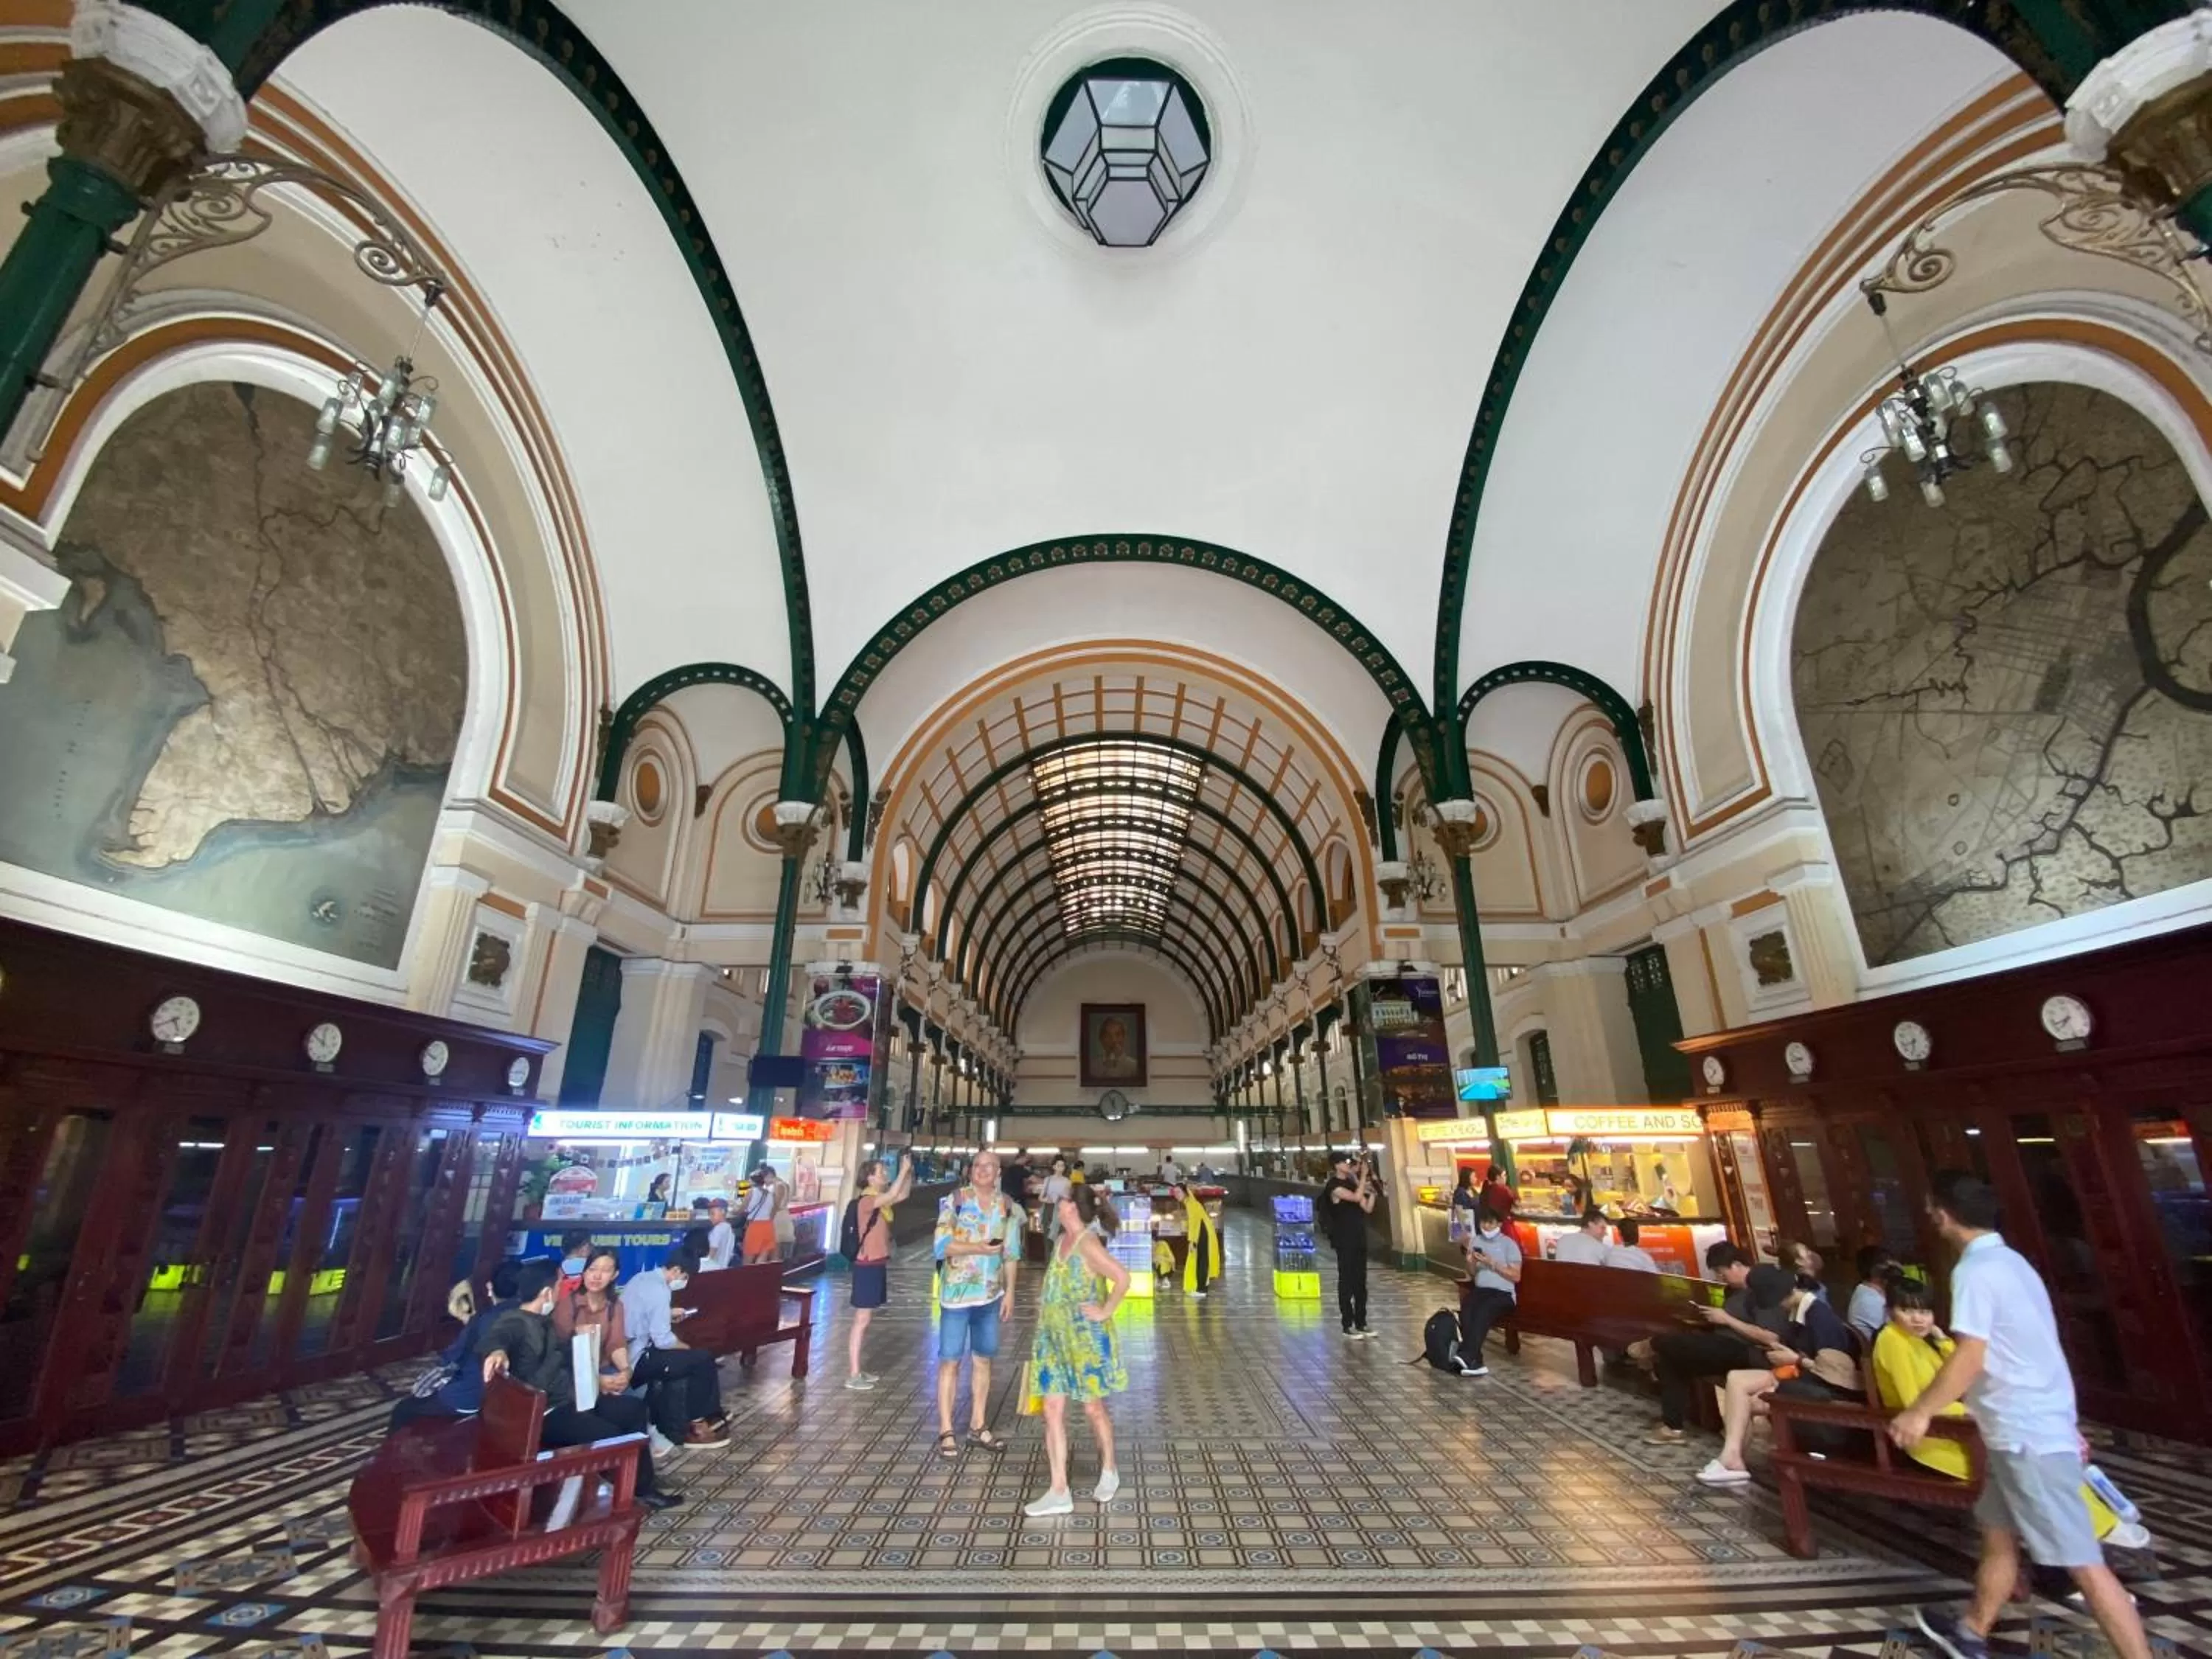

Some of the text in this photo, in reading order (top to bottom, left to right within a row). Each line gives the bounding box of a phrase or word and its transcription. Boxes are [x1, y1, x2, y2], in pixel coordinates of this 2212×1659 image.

[559, 1119, 703, 1131] TOURIST INFORMATION
[1573, 1115, 1638, 1130] COFFEE
[1644, 1116, 1676, 1129] AND
